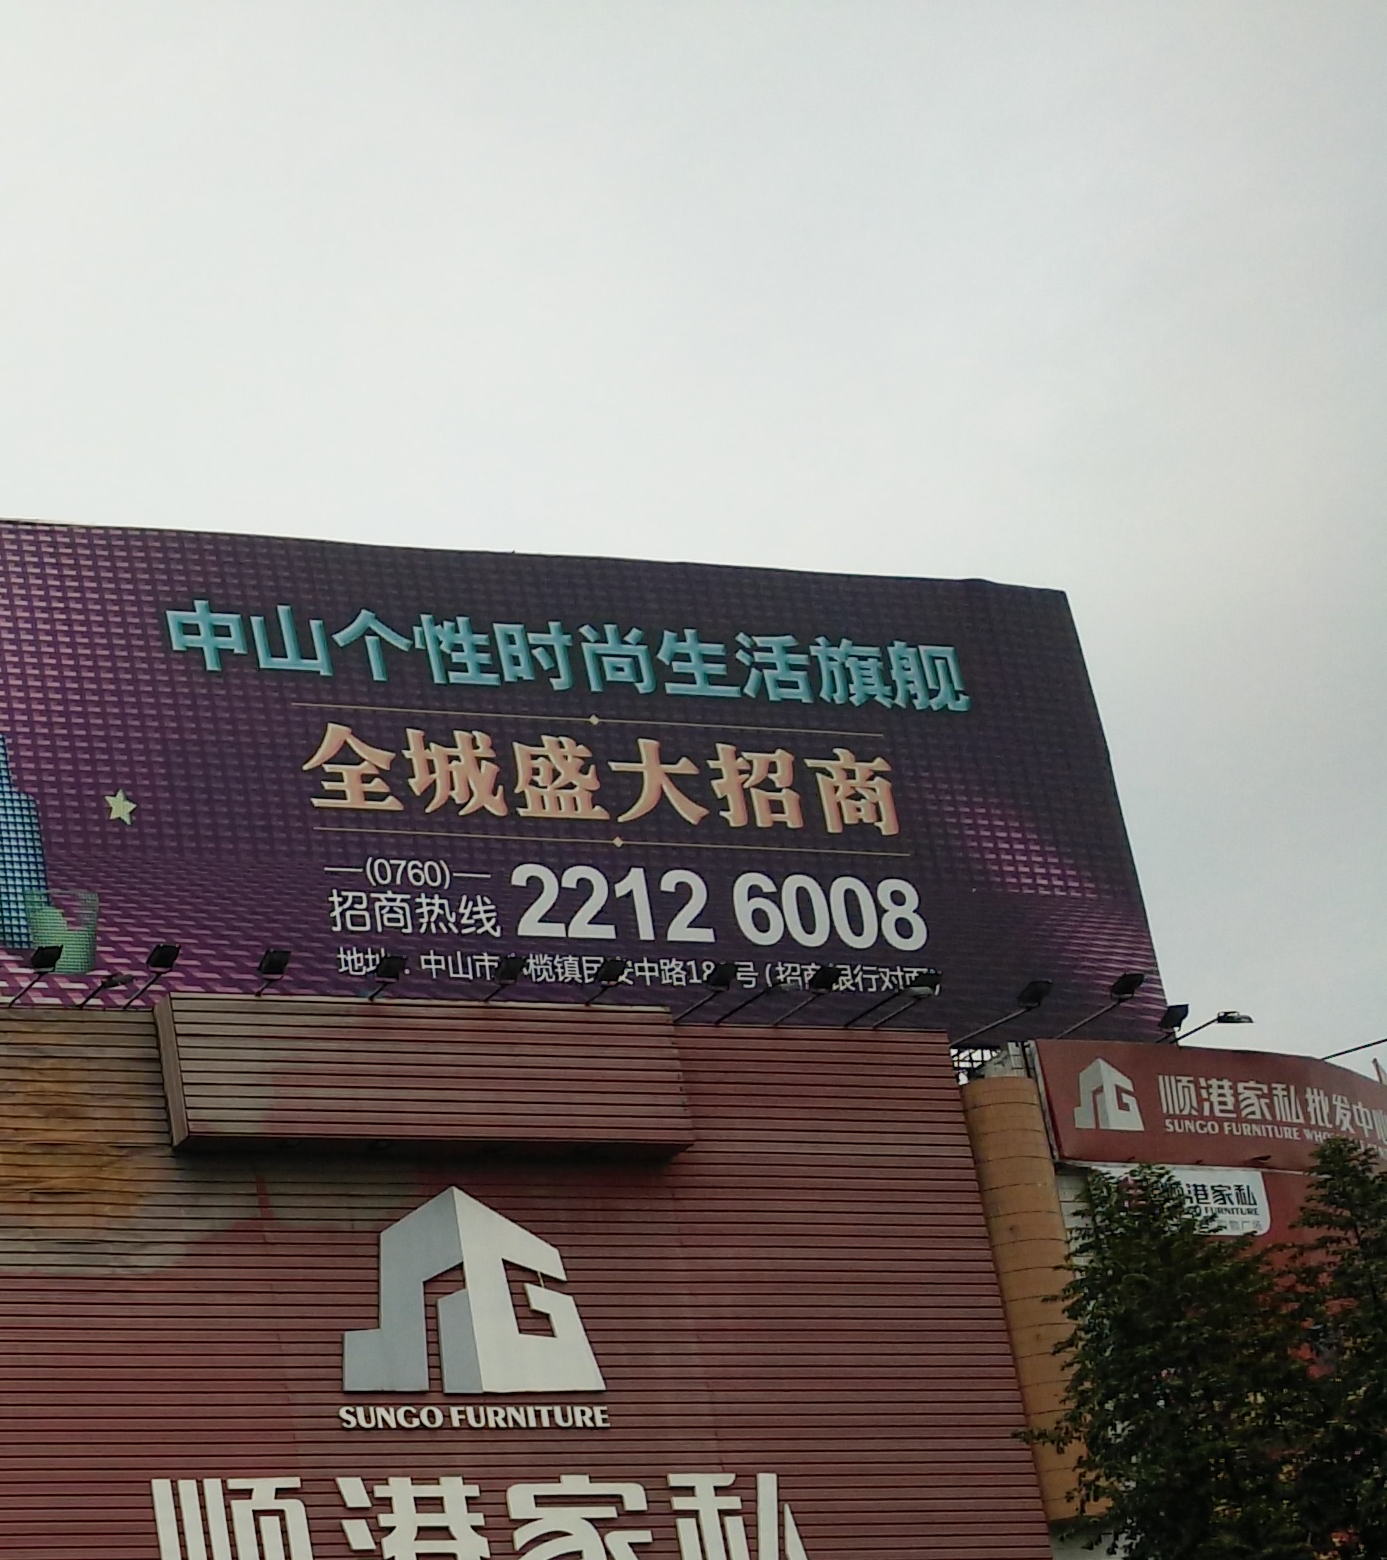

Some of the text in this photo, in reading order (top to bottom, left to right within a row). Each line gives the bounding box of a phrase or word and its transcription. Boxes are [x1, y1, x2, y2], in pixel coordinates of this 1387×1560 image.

[164, 597, 972, 713] 中山个性时尚生活旗舰
[300, 722, 902, 838] 全城盛大招商
[327, 888, 503, 939] 招商热线
[510, 863, 929, 952] 2212 6008
[1163, 1119, 1302, 1142] SUNGO FURNITURE
[338, 1403, 612, 1430] SUNGO FURNITURE
